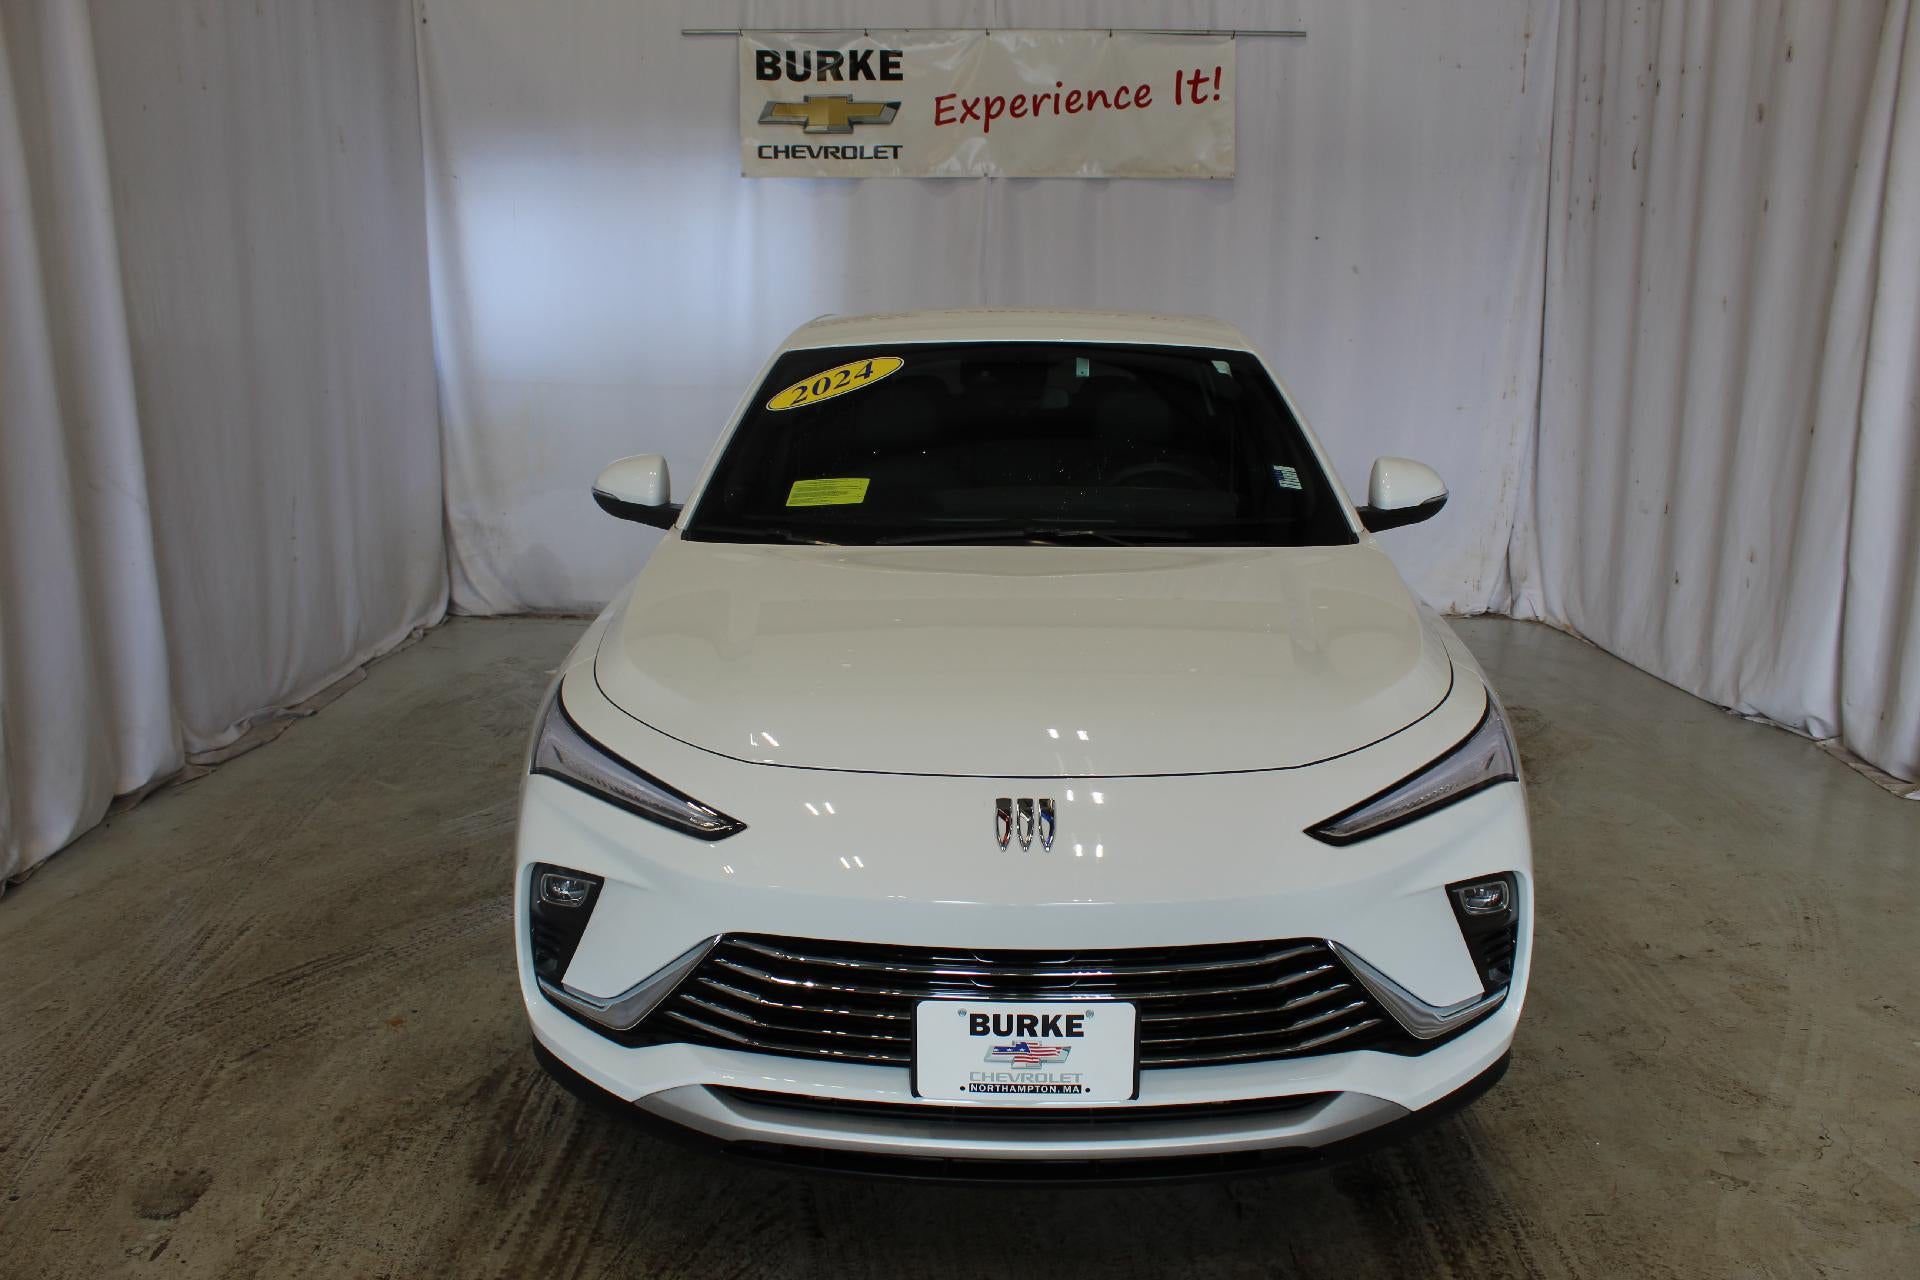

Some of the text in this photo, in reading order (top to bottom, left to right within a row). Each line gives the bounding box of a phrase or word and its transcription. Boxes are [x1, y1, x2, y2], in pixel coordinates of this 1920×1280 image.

[755, 49, 904, 82] BURKE
[934, 66, 1222, 133] Experience It!
[757, 144, 903, 160] CHEVROLET
[791, 360, 873, 405] 2024
[969, 1013, 1085, 1038] BURKE
[969, 1071, 1083, 1084] CHEVROLET
[1063, 1085, 1080, 1093] MA
